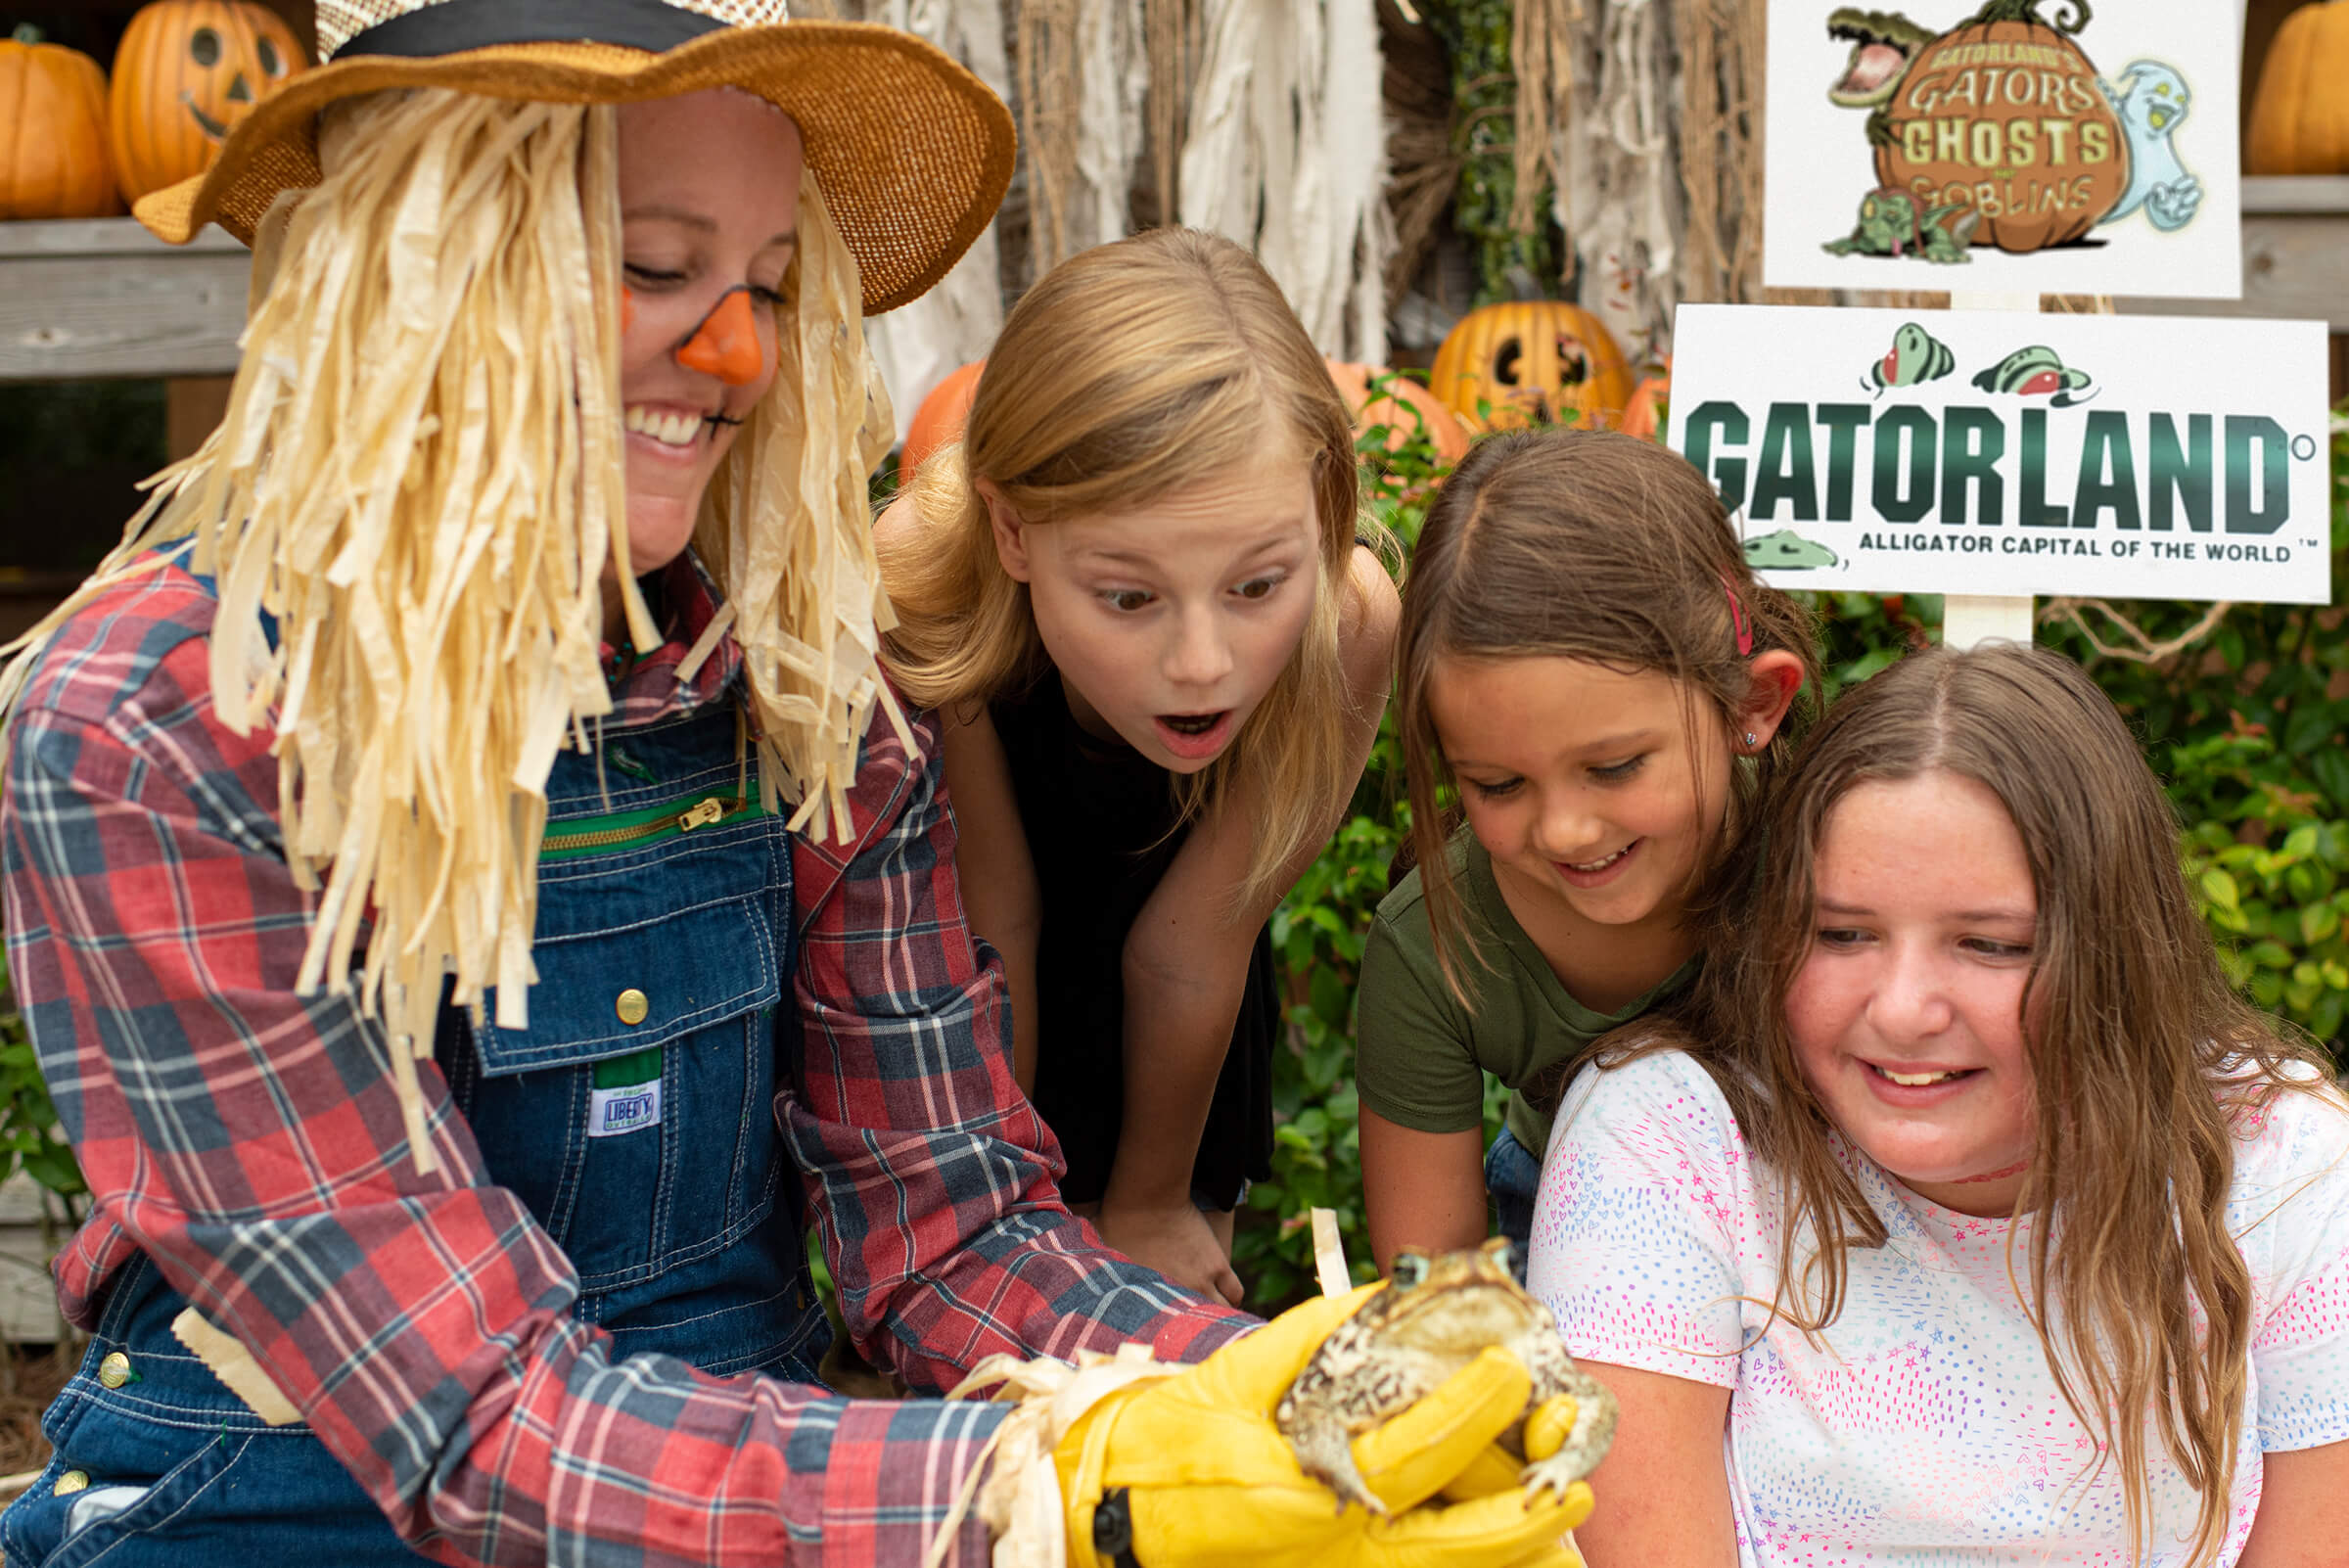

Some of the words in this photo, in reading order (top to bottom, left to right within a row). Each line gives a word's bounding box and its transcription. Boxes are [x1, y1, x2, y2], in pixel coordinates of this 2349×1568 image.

[1910, 68, 2096, 115] GATORS
[1903, 117, 2109, 167] GHOSTS
[1910, 174, 2096, 217] GOBLINS
[1684, 401, 2289, 534] GATORLAND
[1860, 532, 1994, 552] ALLIGATOR
[2002, 536, 2102, 556] CAPITAL
[2110, 540, 2142, 557] OF
[2150, 542, 2196, 559] THE
[2205, 544, 2291, 563] WORLD
